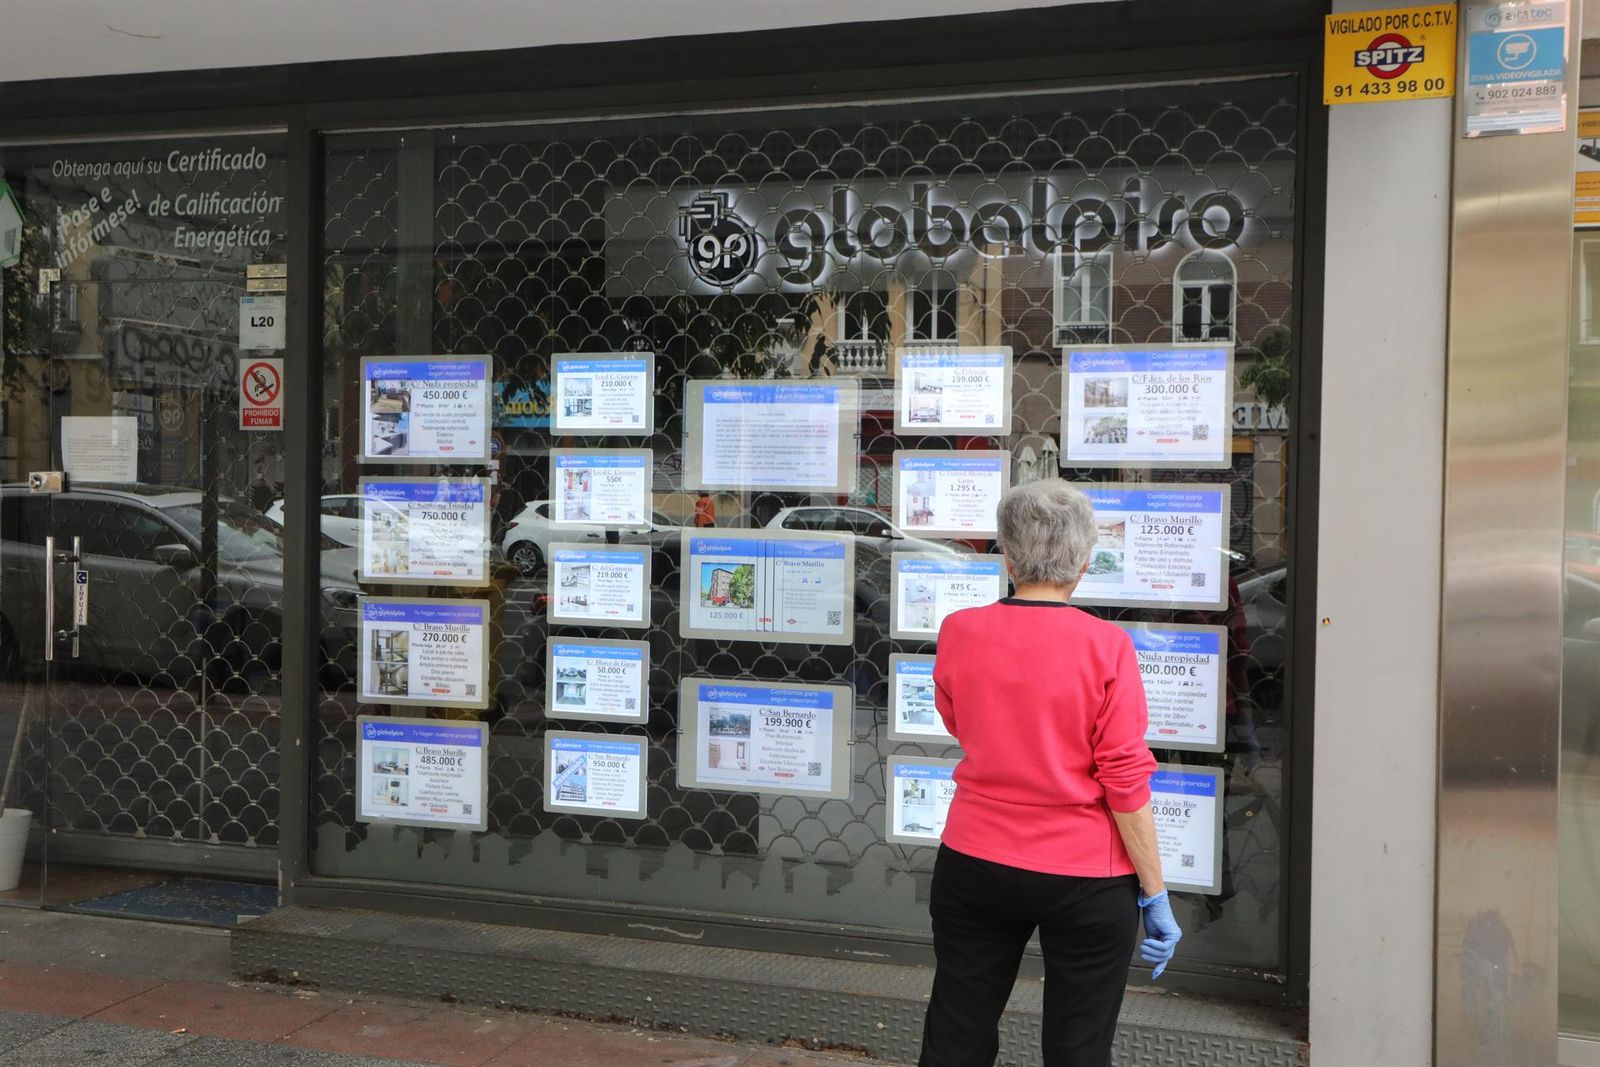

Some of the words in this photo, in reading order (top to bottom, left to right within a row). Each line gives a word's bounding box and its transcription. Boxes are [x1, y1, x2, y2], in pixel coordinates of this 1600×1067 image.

[1330, 17, 1382, 34] VIGILADO
[1385, 15, 1409, 30] POR
[1412, 10, 1453, 28] C.C.T.V.
[1357, 47, 1423, 66] SPITZ
[1333, 84, 1352, 97] 91
[1360, 82, 1391, 95] 433
[1397, 80, 1418, 93] 98
[1424, 78, 1445, 91] 00
[1488, 89, 1508, 99] 902
[1511, 88, 1532, 98] 024
[1535, 85, 1556, 96] 889
[52, 160, 111, 180] Obtenga
[114, 157, 145, 179] aquí
[147, 160, 162, 174] su
[167, 147, 266, 172] Certificado
[101, 187, 112, 203] e
[149, 194, 169, 216] de
[174, 191, 280, 216] Calificación
[174, 224, 271, 252] Energética
[250, 316, 275, 328] L20
[1166, 374, 1177, 382] de
[1178, 374, 1190, 382] los
[1145, 384, 1189, 394] 300.000
[1192, 384, 1199, 393] €
[423, 390, 459, 399] 450.000
[462, 390, 469, 399] €
[244, 409, 279, 417] PROHIBIDO
[250, 417, 273, 425] FUMAR
[421, 511, 458, 520] 750.000
[461, 511, 467, 520] €
[1143, 515, 1168, 523] Bravo
[1170, 515, 1203, 524] Murillo
[1141, 525, 1184, 535] 125.000
[1188, 526, 1194, 535] €
[801, 560, 824, 568] Murillo
[708, 611, 737, 619] 125.000
[424, 623, 444, 631] Bravo
[445, 624, 471, 632] Murillo
[422, 632, 458, 642] 270.000
[461, 634, 467, 643] €
[1138, 651, 1162, 661] Nuda
[1164, 653, 1210, 664] propiedad
[597, 666, 620, 674] 50.000
[1189, 666, 1197, 676] €
[783, 709, 816, 719] Bernardo
[765, 717, 803, 728] 199.900
[806, 720, 812, 728] €
[420, 756, 455, 765] 485.000
[457, 757, 463, 766] €
[592, 760, 620, 768] 950.000
[621, 761, 627, 769] €
[1180, 780, 1211, 788] prioridad
[1184, 808, 1191, 818] €
